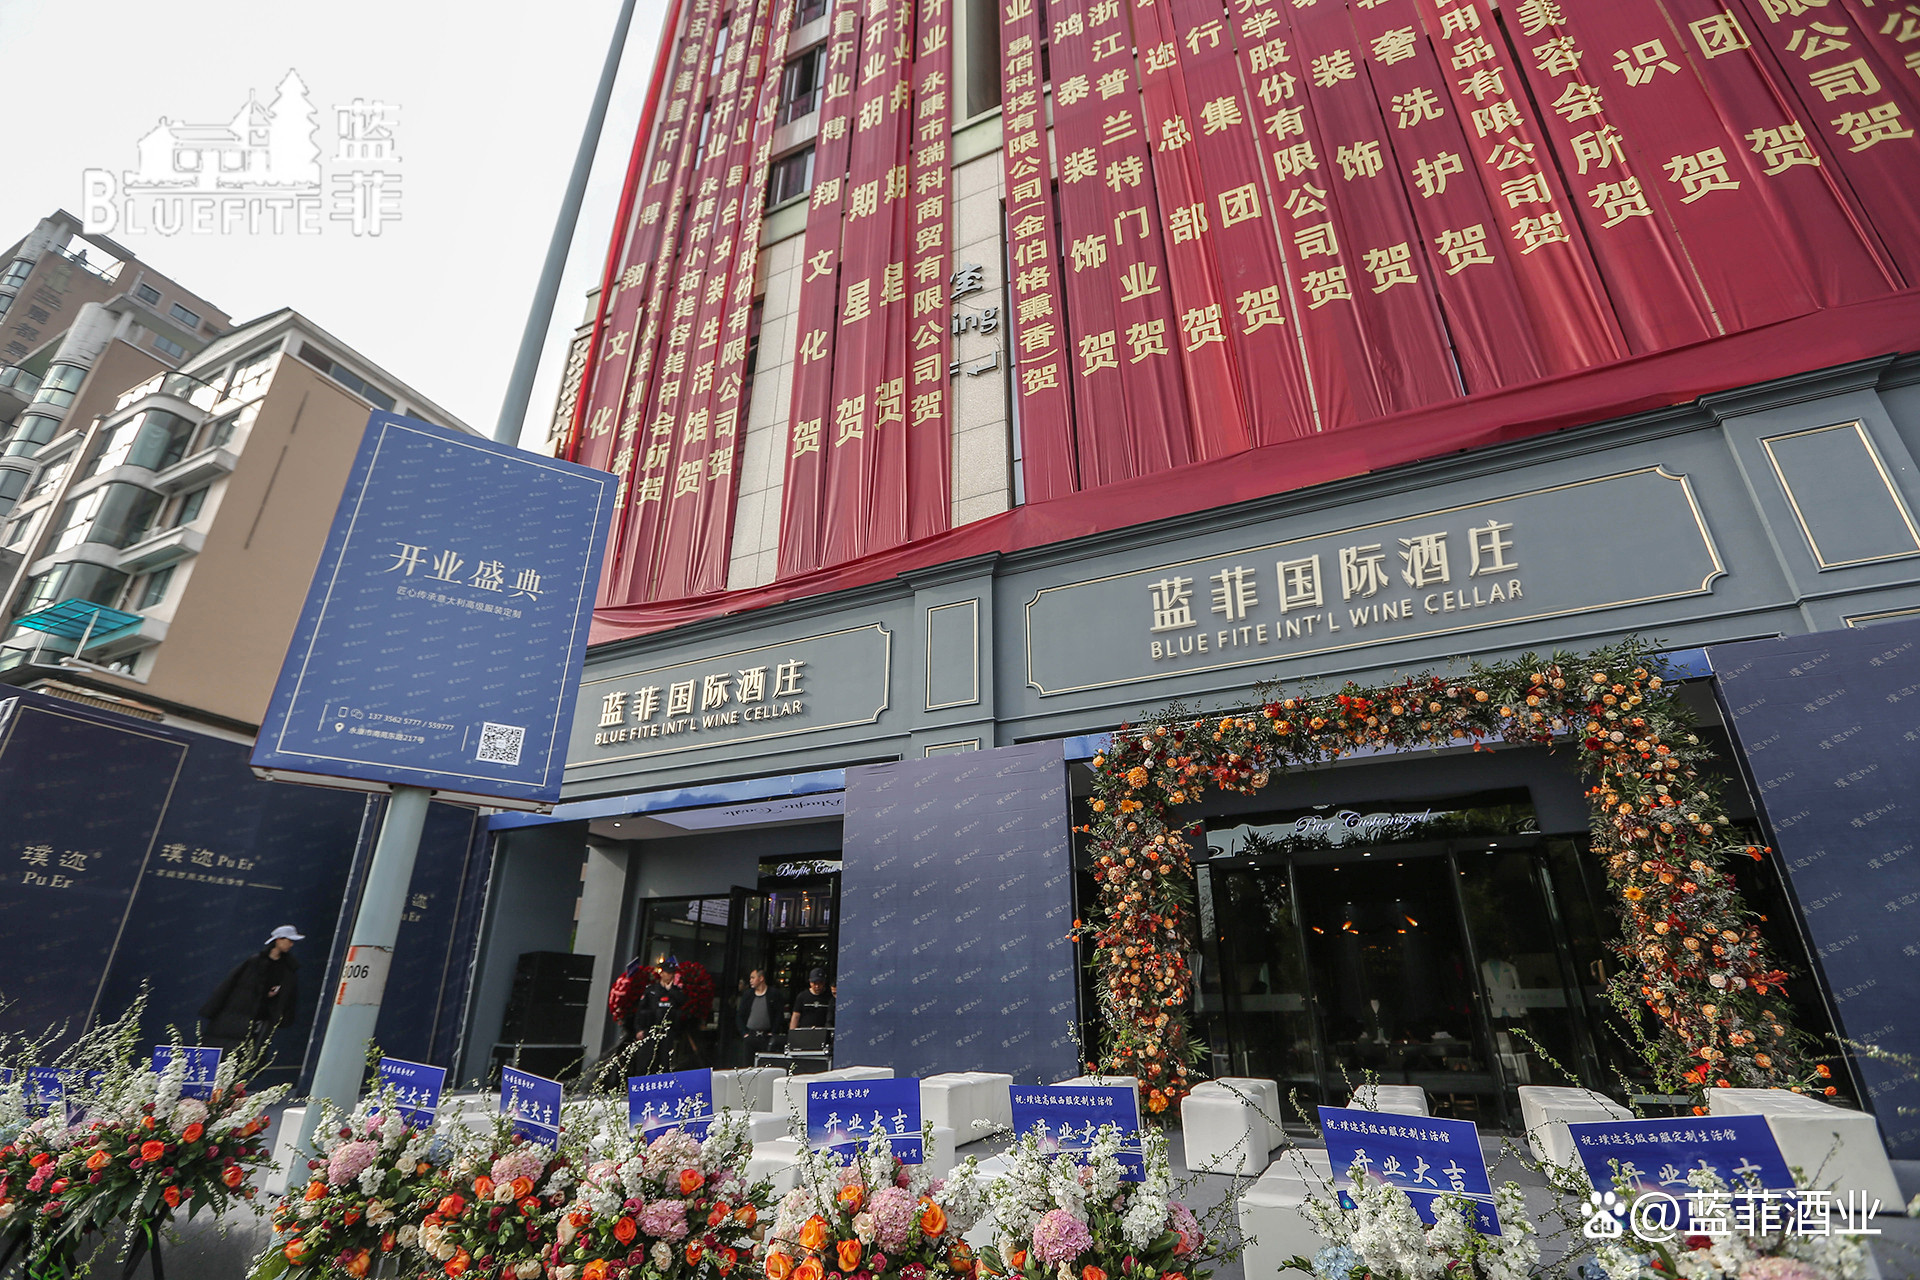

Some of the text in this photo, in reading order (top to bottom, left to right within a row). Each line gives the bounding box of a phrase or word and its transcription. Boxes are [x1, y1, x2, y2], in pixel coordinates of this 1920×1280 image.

[384, 541, 545, 602] 开业盛典
[1148, 519, 1520, 633] 蓝菲国际酒庄
[1150, 633, 1209, 660] BLUE
[1217, 624, 1269, 649] FITE
[1349, 599, 1413, 627] WINE
[1425, 579, 1523, 615] CELLAR
[594, 730, 627, 746] BLUE
[629, 724, 659, 740] FITE
[702, 710, 739, 730] WINE
[743, 700, 803, 722] CELLAR
[598, 658, 806, 728] 蓝菲国际酒庄
[823, 1108, 908, 1134] 开业大吉
[1350, 1148, 1467, 1192] 开业大吉
